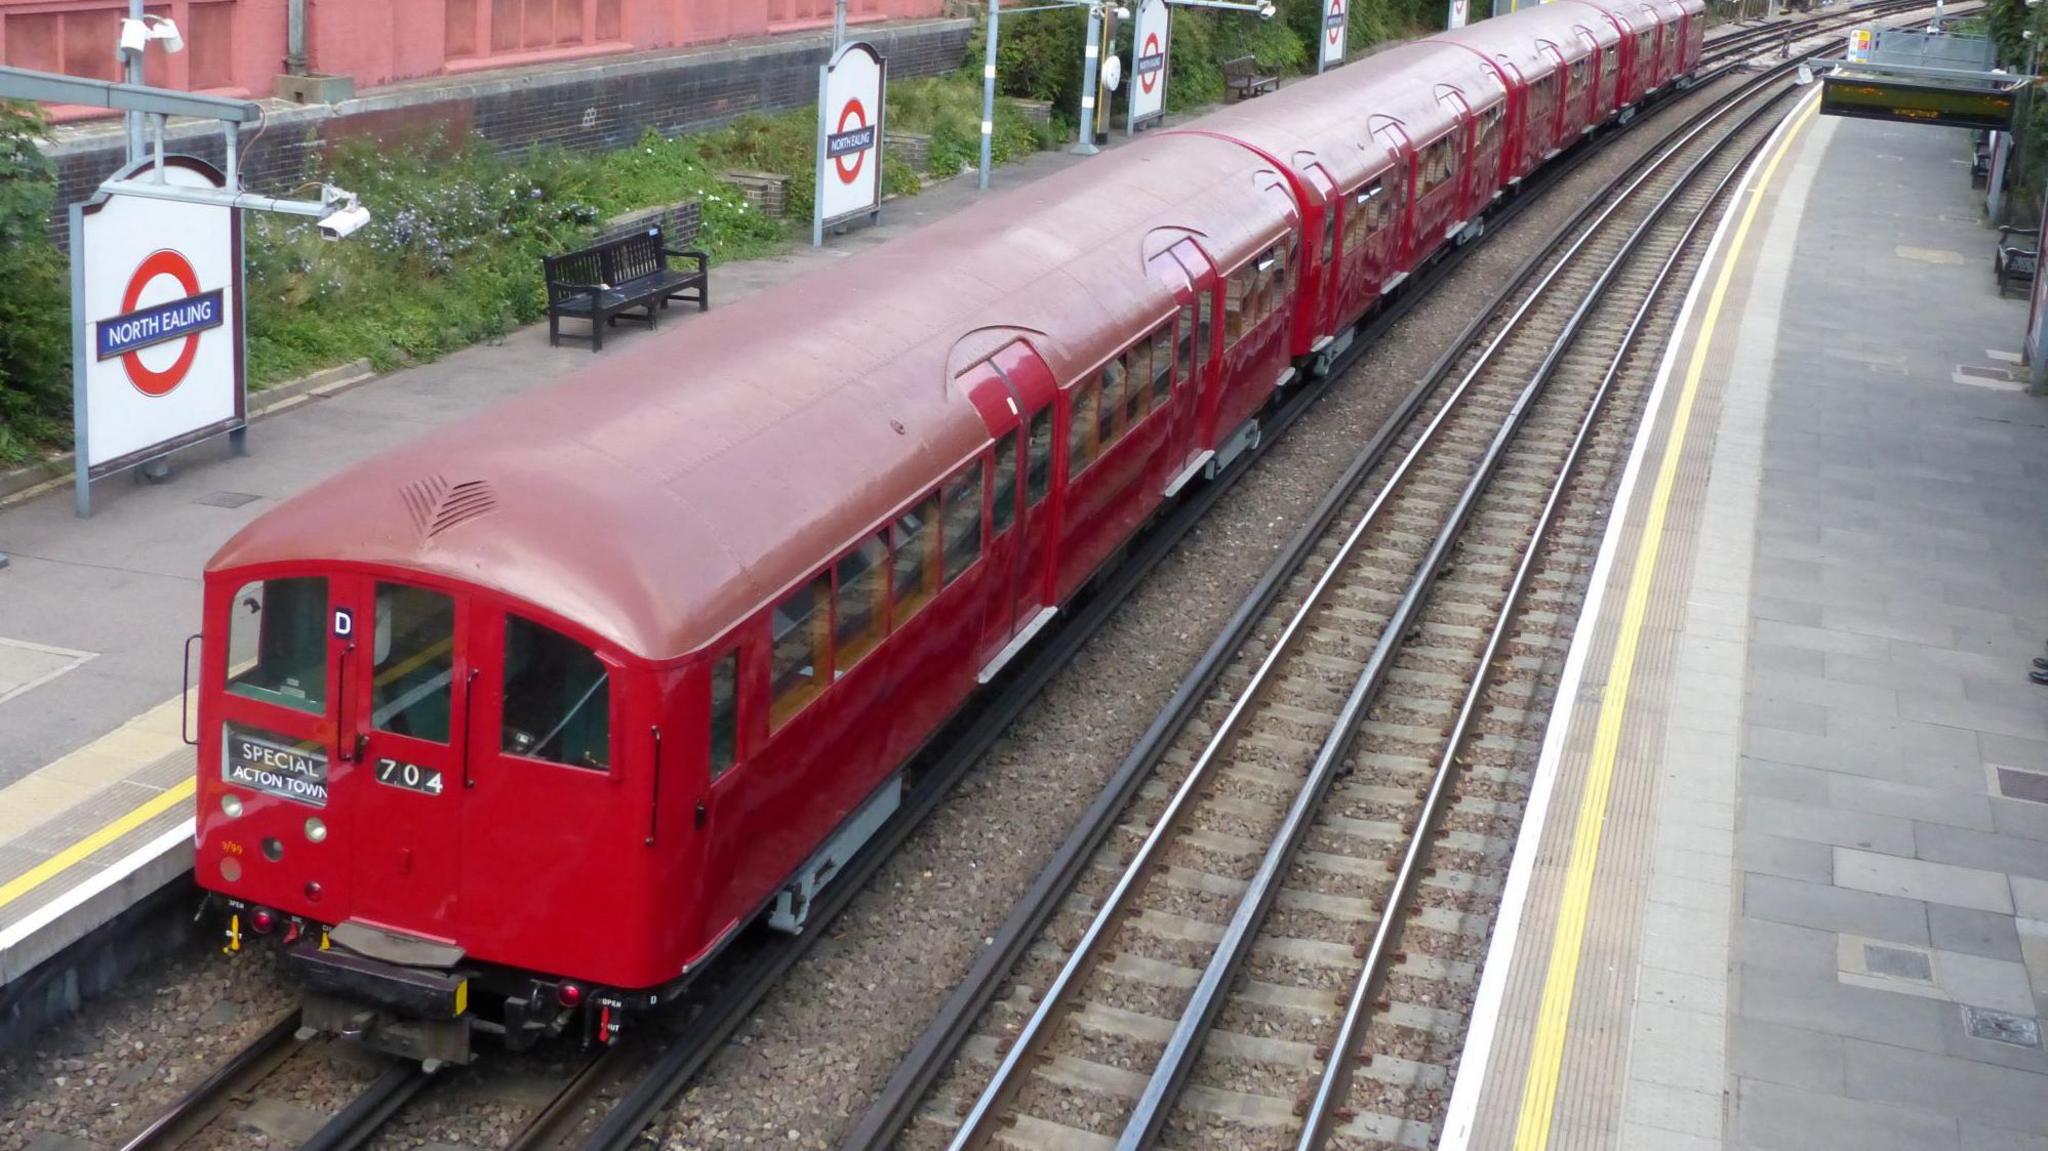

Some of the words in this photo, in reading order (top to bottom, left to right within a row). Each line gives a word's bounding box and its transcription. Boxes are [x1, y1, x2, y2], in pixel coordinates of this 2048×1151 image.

[831, 135, 851, 152] NORTH
[851, 130, 871, 148] EALING
[108, 315, 160, 346] NORTH
[162, 301, 212, 331] EALING
[335, 612, 352, 635] D
[242, 743, 320, 778] SPECIAL
[380, 758, 444, 794] 704
[232, 765, 283, 788] ACTON
[286, 777, 328, 799] TOWN
[601, 998, 622, 1008] OPEN
